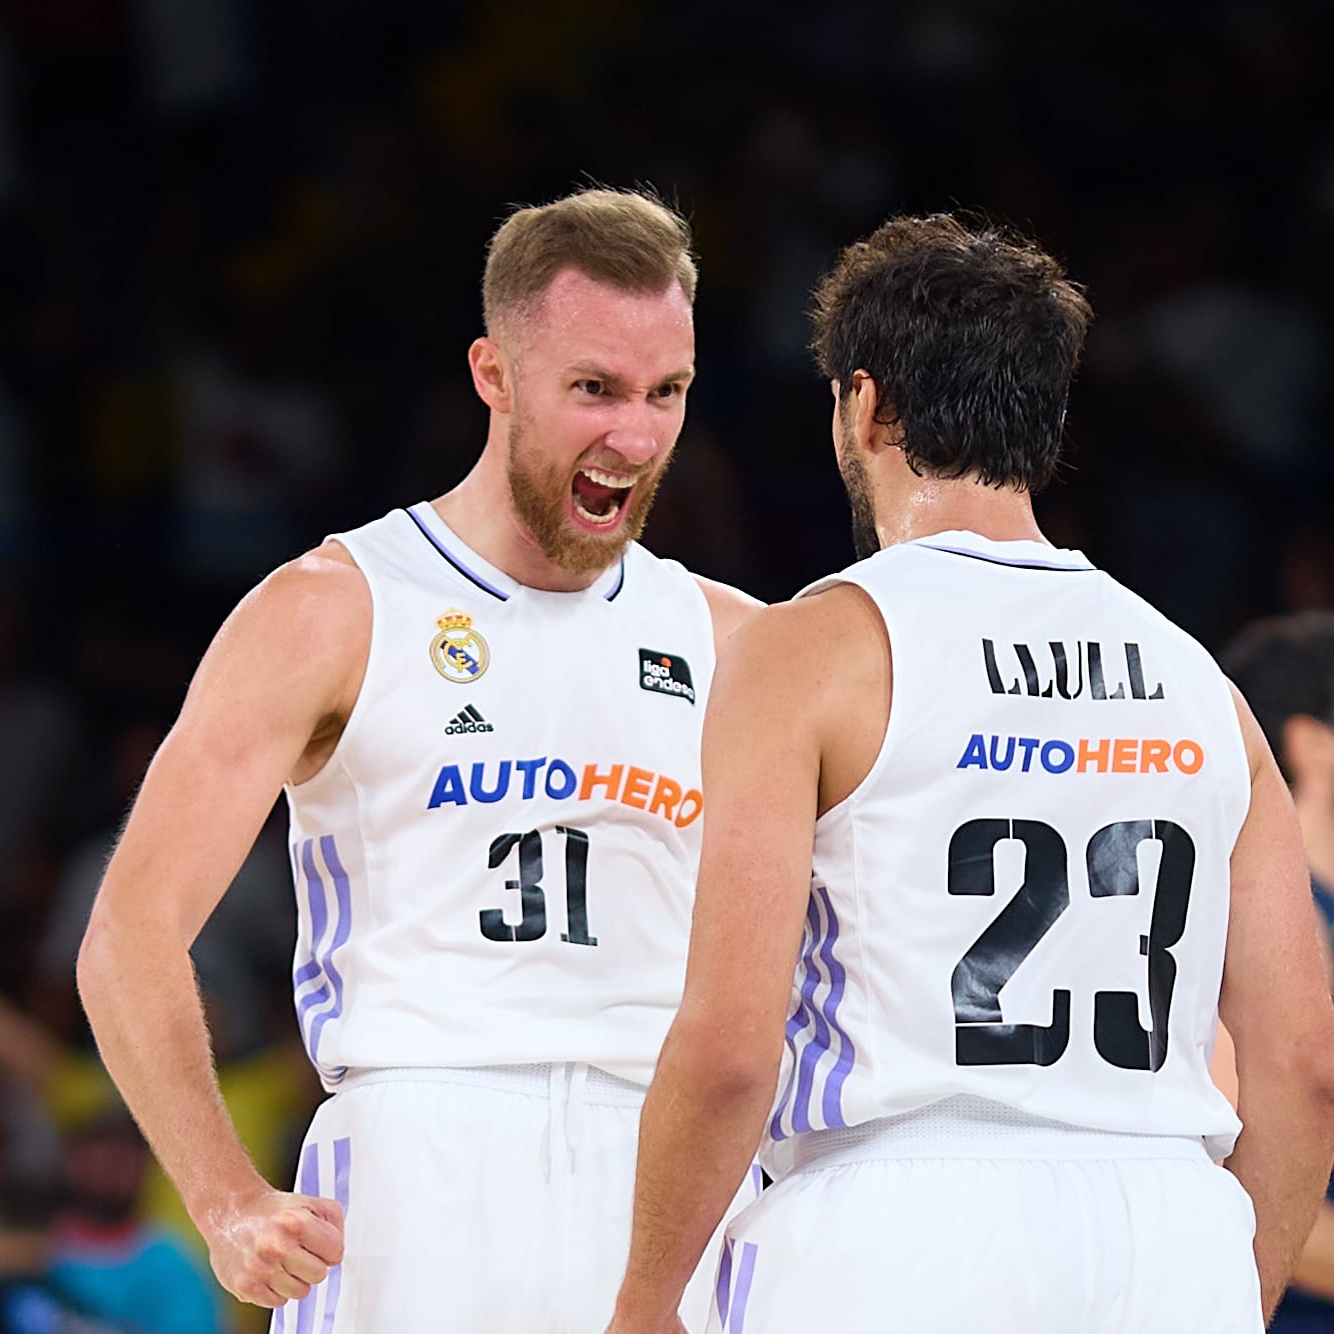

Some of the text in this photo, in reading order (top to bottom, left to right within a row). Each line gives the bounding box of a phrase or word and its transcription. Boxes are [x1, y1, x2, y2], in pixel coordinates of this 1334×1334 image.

[643, 660, 670, 678] liga
[981, 637, 1165, 700] LLULL
[444, 721, 494, 735] adidas
[956, 733, 1205, 775] AUTOHERO
[427, 756, 705, 829] AUTOHERO
[479, 824, 599, 947] 31
[947, 817, 1197, 1073] 23
